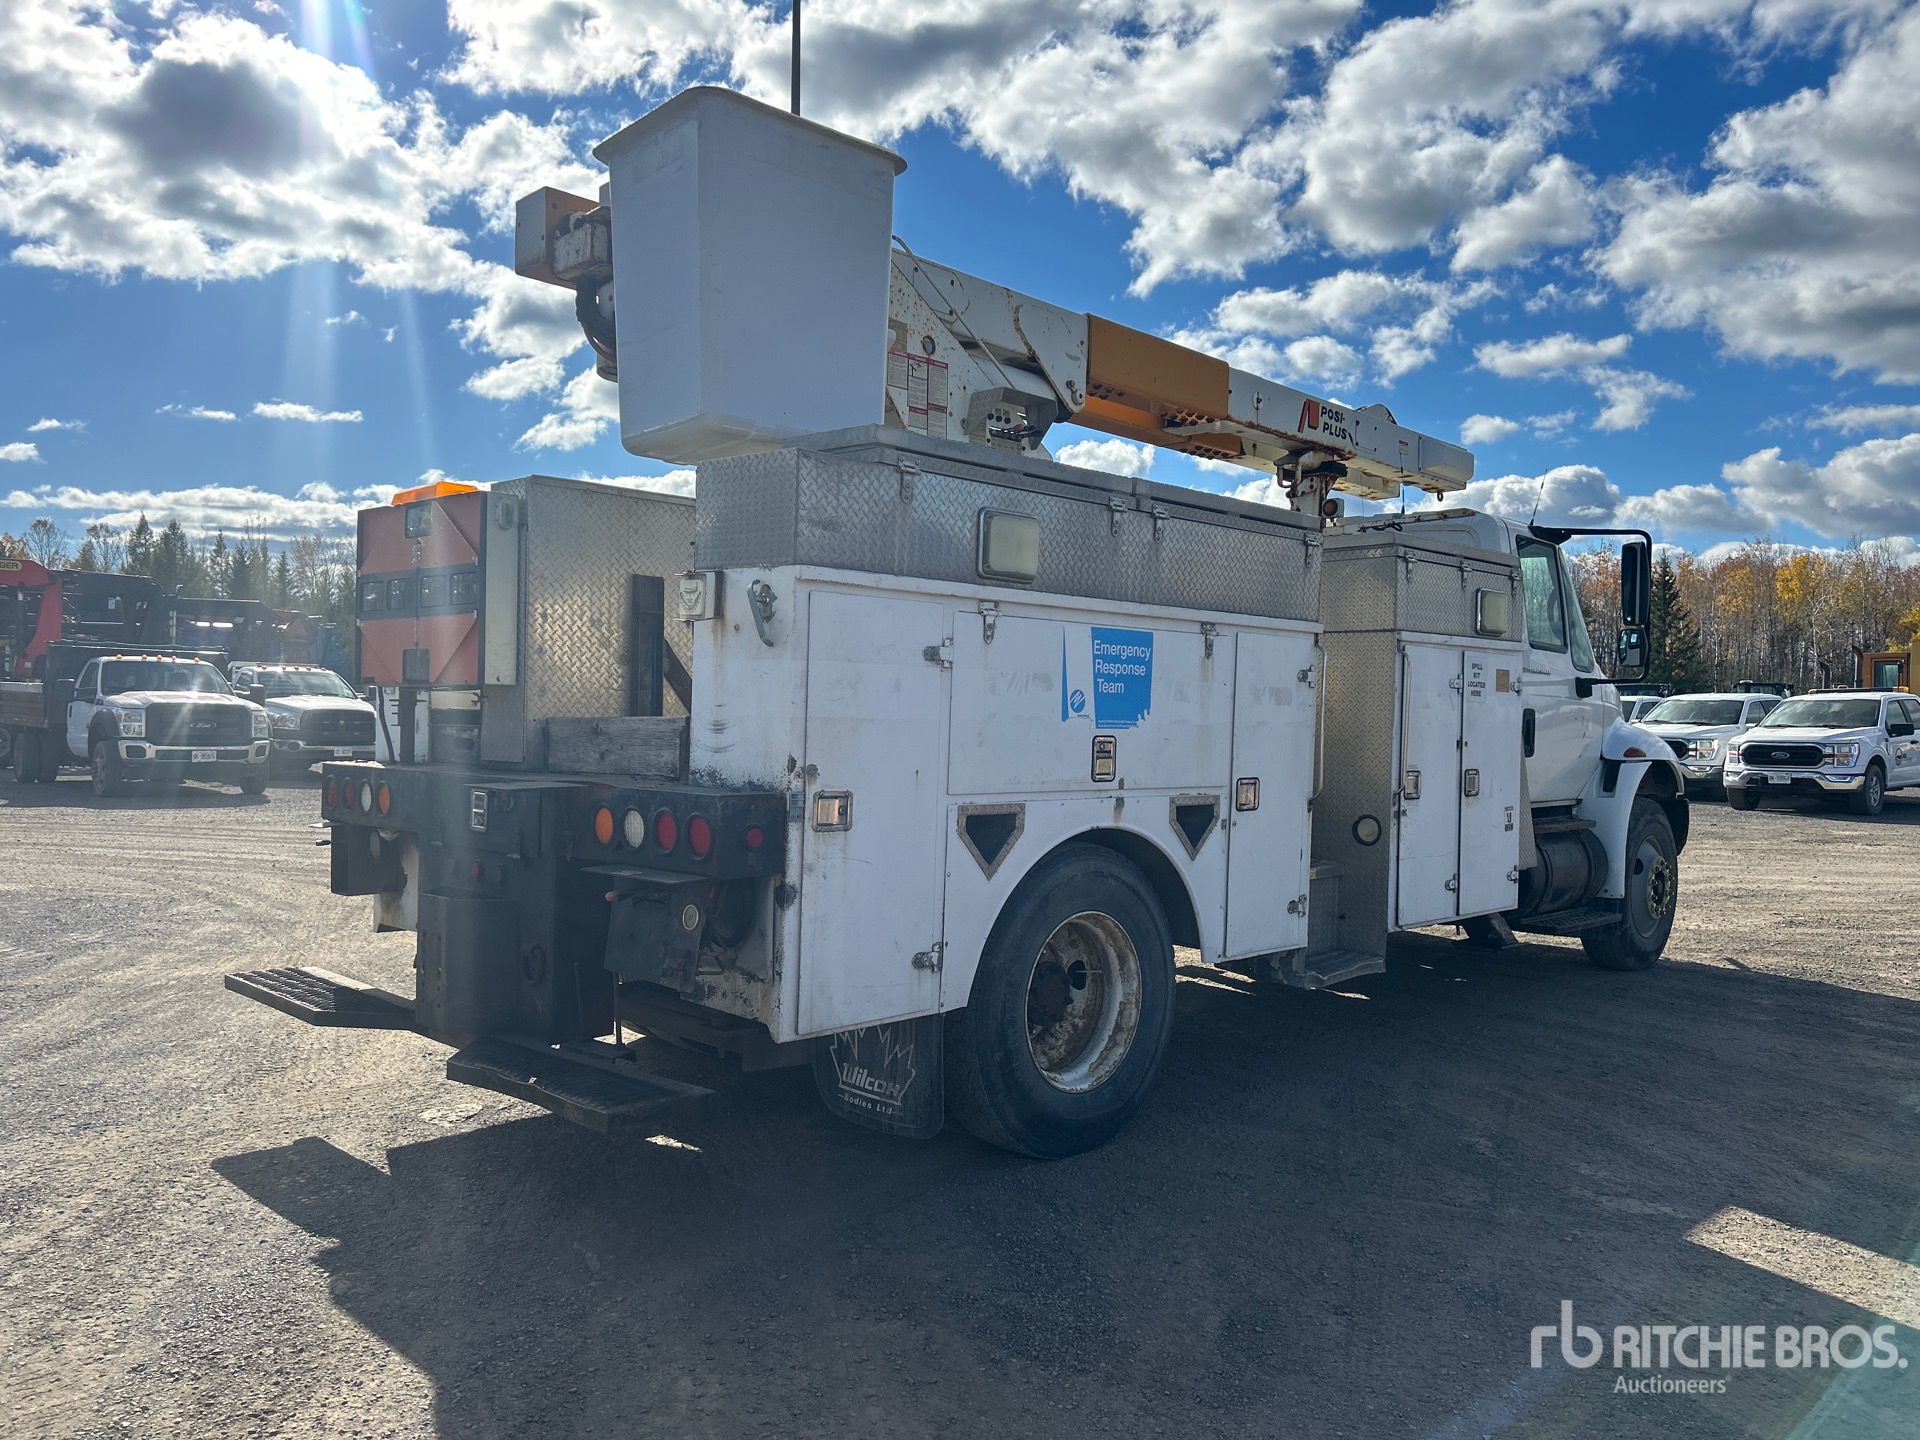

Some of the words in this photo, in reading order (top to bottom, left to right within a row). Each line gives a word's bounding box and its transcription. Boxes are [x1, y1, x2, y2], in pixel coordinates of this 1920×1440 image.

[1320, 406, 1345, 424] POSI-
[1322, 422, 1348, 440] PLUS
[1093, 640, 1152, 661] Emergency
[1095, 659, 1146, 677] Response
[1471, 663, 1483, 671] SPILL
[1097, 678, 1125, 693] Team
[1467, 681, 1486, 689] LOCATED
[844, 1093, 872, 1109] Bodies
[876, 1103, 893, 1115] Ltd
